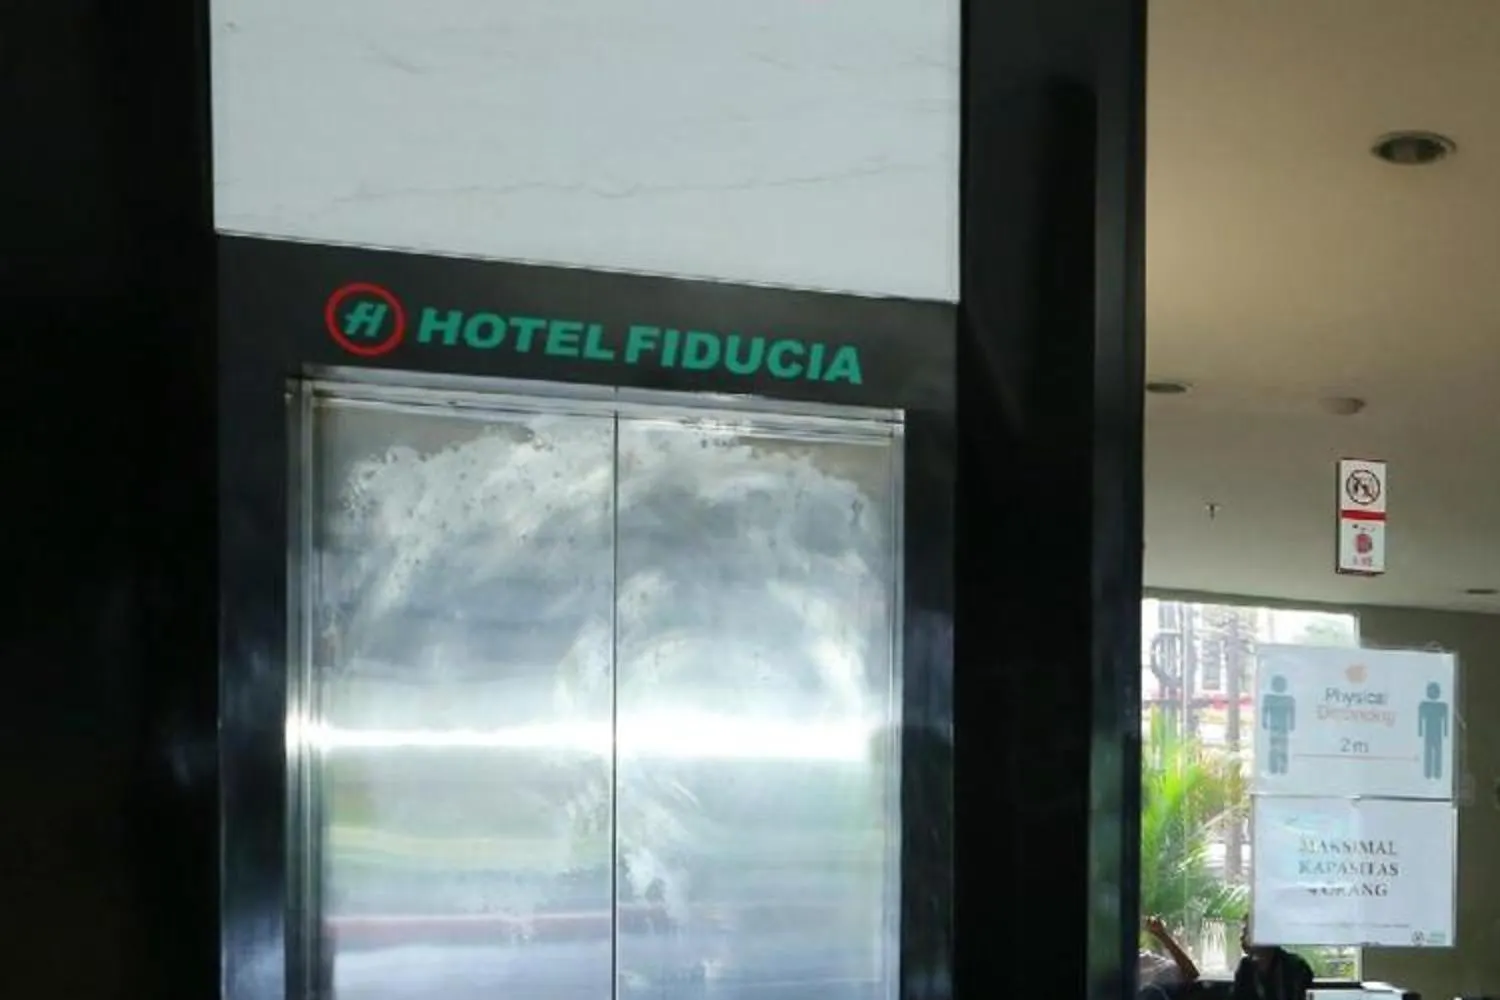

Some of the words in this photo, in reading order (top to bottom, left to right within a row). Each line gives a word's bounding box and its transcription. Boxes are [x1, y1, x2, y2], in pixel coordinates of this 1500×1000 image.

[418, 308, 614, 360] HOTEL
[624, 325, 864, 385] FIDUCIA
[1324, 687, 1388, 708] Physical
[1298, 839, 1399, 856] MAKSIMAL
[1297, 859, 1400, 876] KAPASITAS
